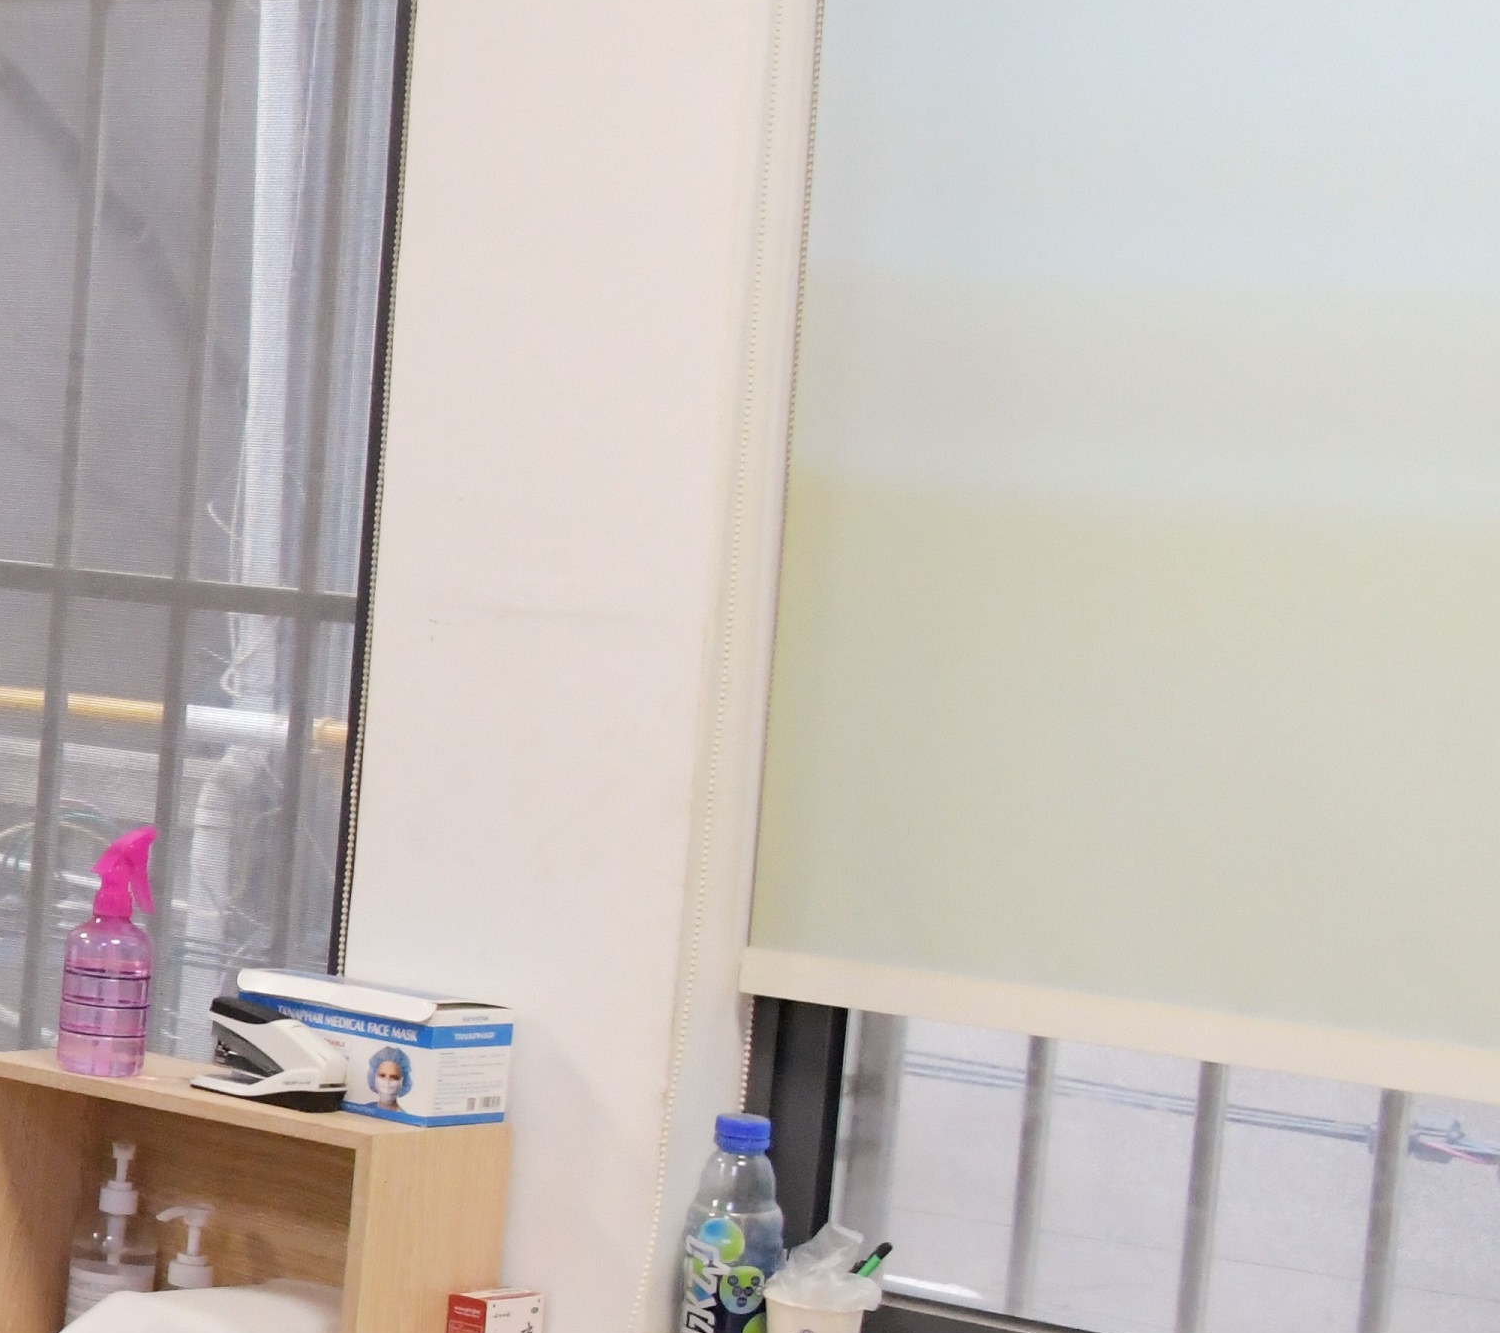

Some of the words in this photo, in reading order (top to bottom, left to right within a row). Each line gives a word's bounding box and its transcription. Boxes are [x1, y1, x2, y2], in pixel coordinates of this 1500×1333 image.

[324, 1015, 367, 1033] MEDICAL
[367, 1021, 391, 1037] FACE
[391, 1027, 419, 1043] MASK
